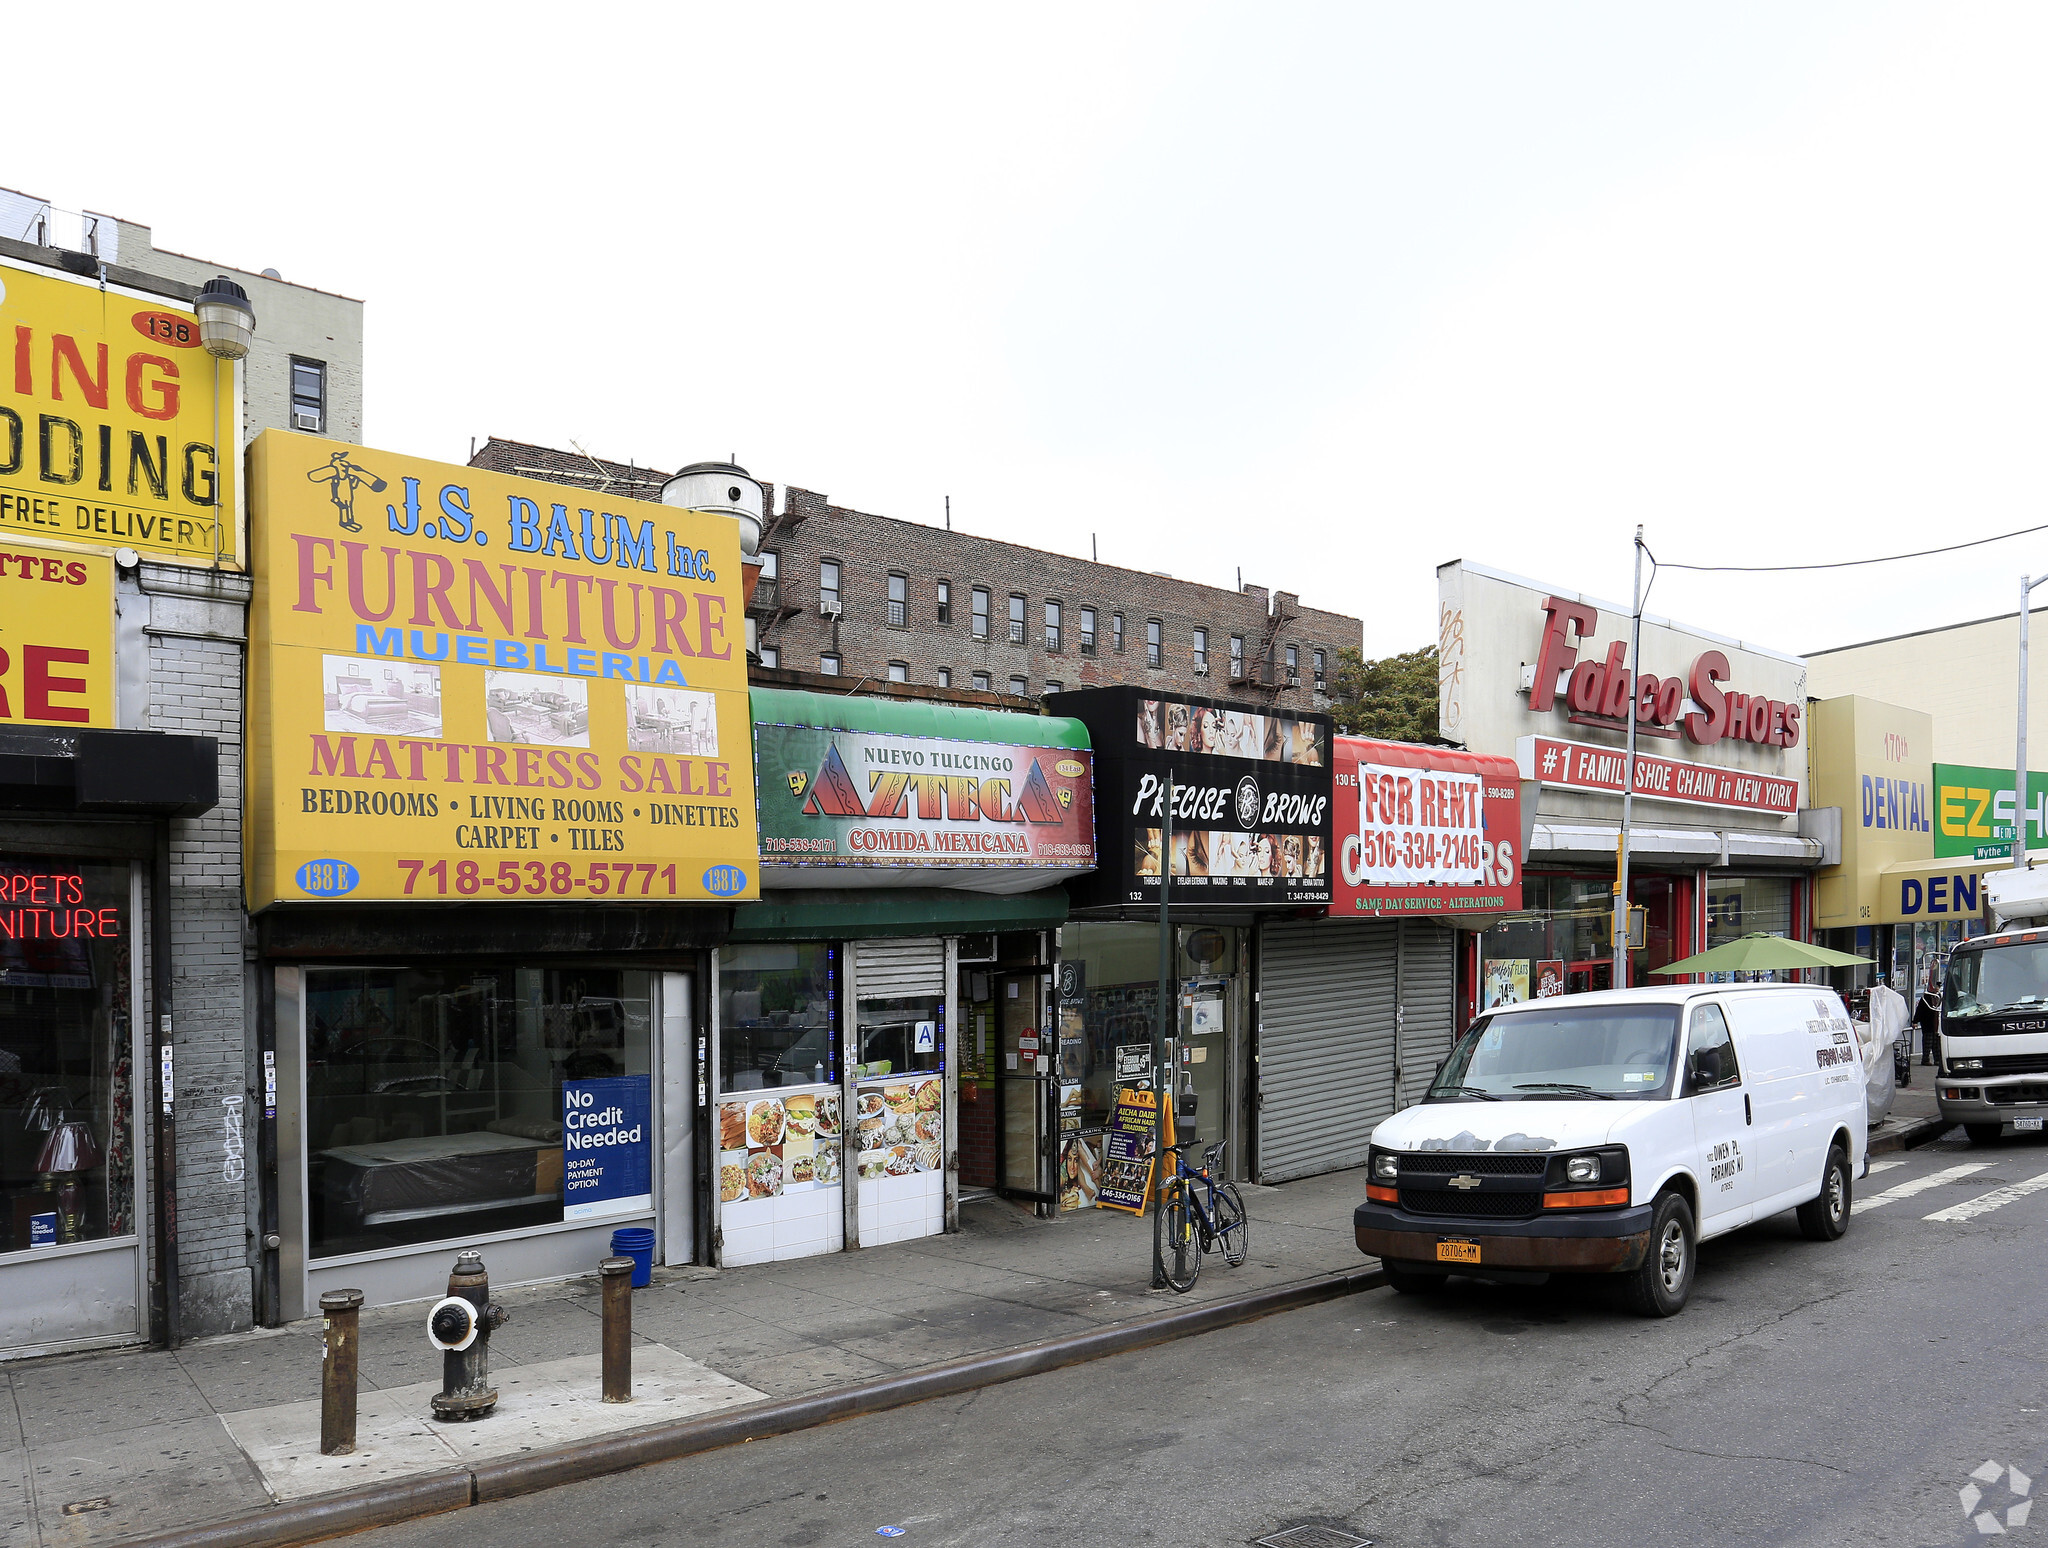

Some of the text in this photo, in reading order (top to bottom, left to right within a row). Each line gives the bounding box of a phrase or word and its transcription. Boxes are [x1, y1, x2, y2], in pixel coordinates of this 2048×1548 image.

[149, 317, 190, 343] 138
[15, 325, 180, 421] ING
[1, 494, 215, 547] FREE DELIVERY
[387, 477, 716, 582] J.S. BAUM Inc.
[290, 534, 733, 661] FURNITURE
[356, 624, 688, 687] MUEBLERIA
[0, 644, 89, 723] E
[1685, 650, 1801, 748] SHOES
[1885, 732, 1908, 762] 170th
[309, 734, 732, 798] MATTRESS SALE
[864, 747, 1014, 772] NUEVO TULCINGO
[802, 740, 1063, 823] AZTECA
[1335, 774, 1348, 786] 130
[1542, 746, 1573, 782] #1
[1635, 761, 1671, 792] SHOE
[1676, 768, 1716, 799] CHAIN
[1719, 775, 1732, 800] in
[1736, 778, 1761, 804] NEW
[1765, 782, 1794, 808] YORK
[1133, 773, 1231, 821] PRECISE
[1262, 792, 1327, 826] BROWS
[1365, 773, 1478, 829] FOR RENT
[1488, 787, 1515, 799] 590-8289
[1862, 774, 1929, 832] DENTAL
[301, 788, 739, 828] BEDROOMS LIVING ROOMS DINETTES
[1940, 786, 2048, 839] EZSH
[456, 825, 624, 851] CARPET TILES
[766, 837, 837, 852] 718-538-2171
[849, 828, 1030, 855] COMIDA MEXICANA
[1365, 830, 1480, 869] 516-334-2146
[1977, 847, 2001, 859] Wythe
[303, 863, 348, 890] 138 E
[397, 860, 678, 895] 718-538-5771
[707, 869, 740, 891] 138 E
[1143, 877, 1161, 886] THREAD
[1212, 878, 1228, 886] WAXING
[1233, 878, 1247, 886] FACIAL
[1257, 878, 1274, 886] MAKE-UP
[1287, 878, 1297, 887] HAIR
[1129, 892, 1143, 901] 132
[1293, 891, 1329, 901] 347-879-8429
[1356, 896, 1504, 910] SAME DAY SERVICE ALTERATIONS
[1901, 874, 1985, 915] DEN
[1486, 958, 1529, 979] Comfort FLATS
[919, 1025, 931, 1044] A
[2002, 1021, 2046, 1031] ISUZU
[566, 1090, 594, 1109] No
[566, 1106, 623, 1130] Credit
[1118, 1108, 1137, 1117] AICHA
[1118, 1116, 1156, 1126] AFRICAN HAIR
[566, 1124, 641, 1151] Needed
[1122, 1124, 1148, 1132] BRAIDING
[1714, 1142, 1729, 1161] OWEN
[567, 1157, 596, 1171] 90-DAY
[567, 1167, 604, 1181] PAYMENT
[1711, 1156, 1744, 1183] PARAMUS NJ
[567, 1178, 599, 1190] OPTION
[573, 1206, 592, 1215] acima
